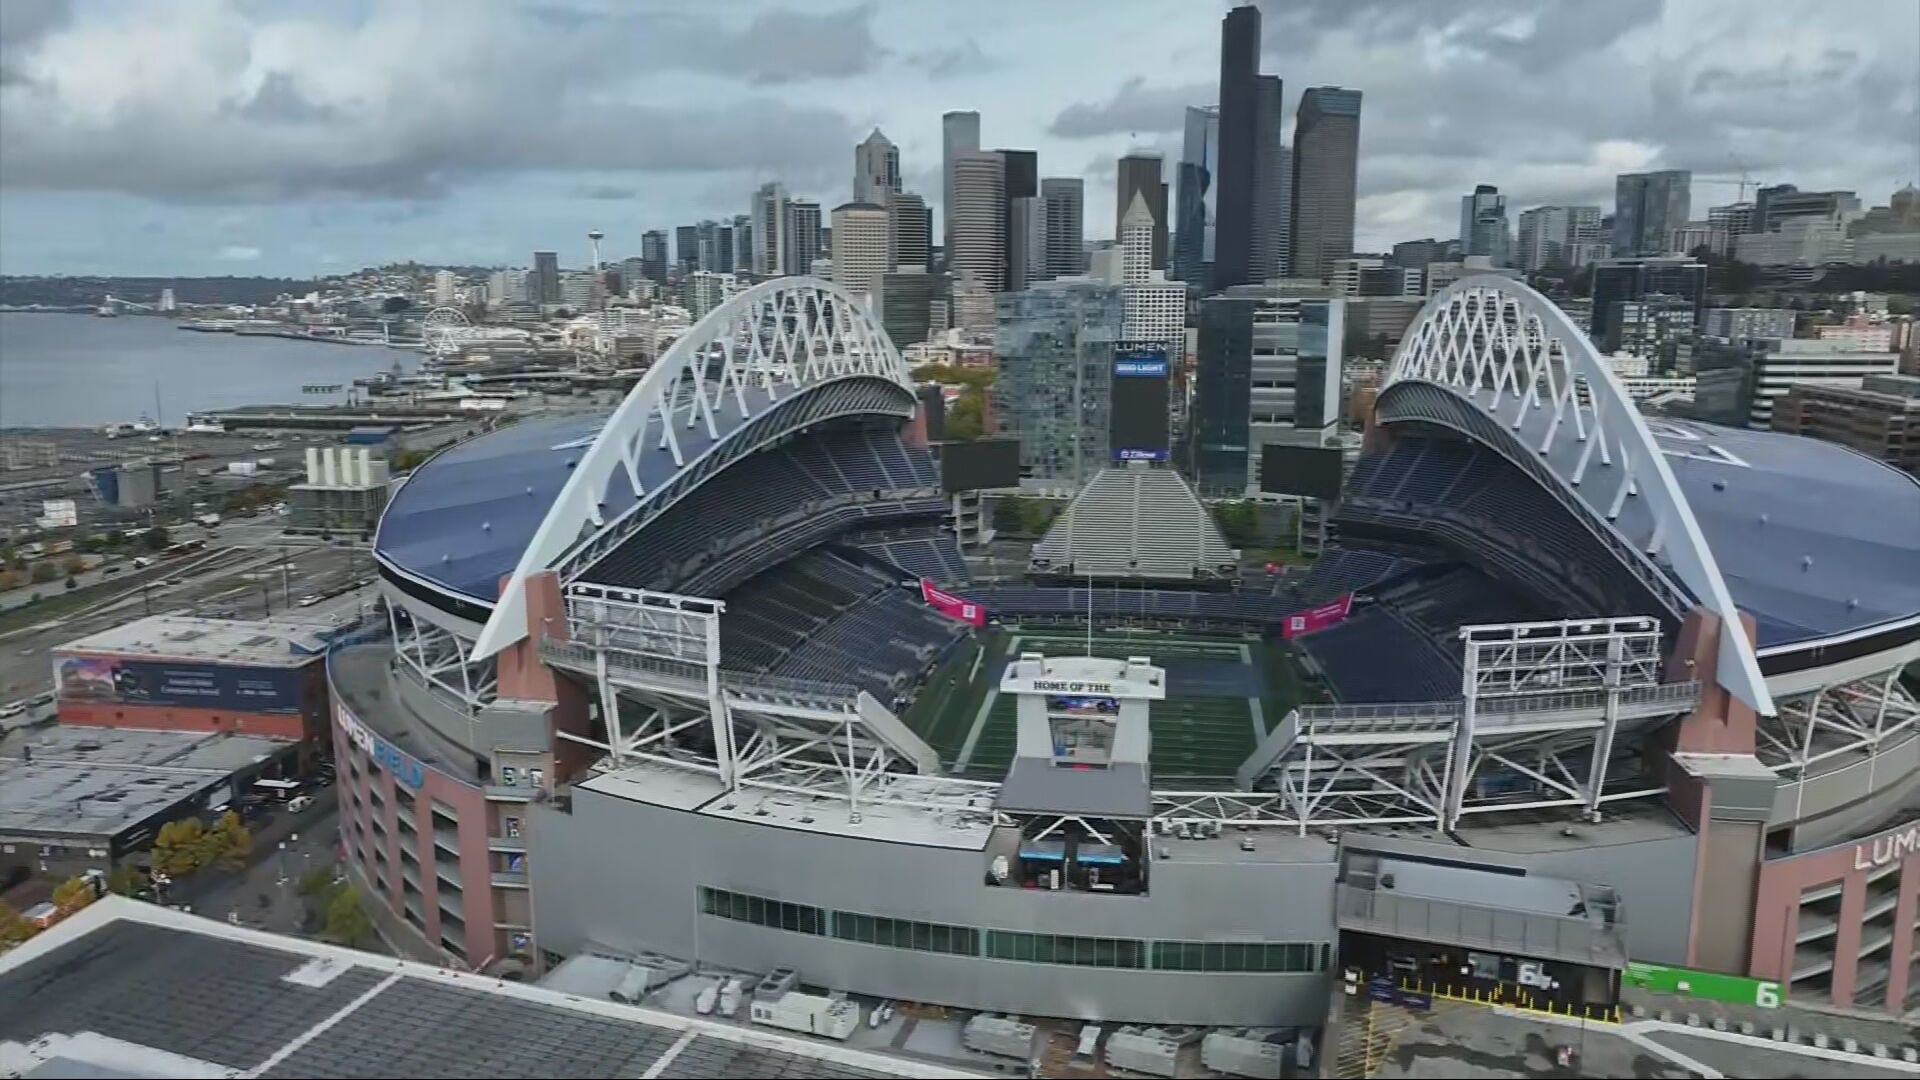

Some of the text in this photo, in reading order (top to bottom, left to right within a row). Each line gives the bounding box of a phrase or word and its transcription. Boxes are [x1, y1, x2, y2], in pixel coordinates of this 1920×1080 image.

[1115, 342, 1168, 352] LUMEN
[1033, 680, 1112, 693] HOME OF THE
[1756, 981, 1780, 1009] 6
